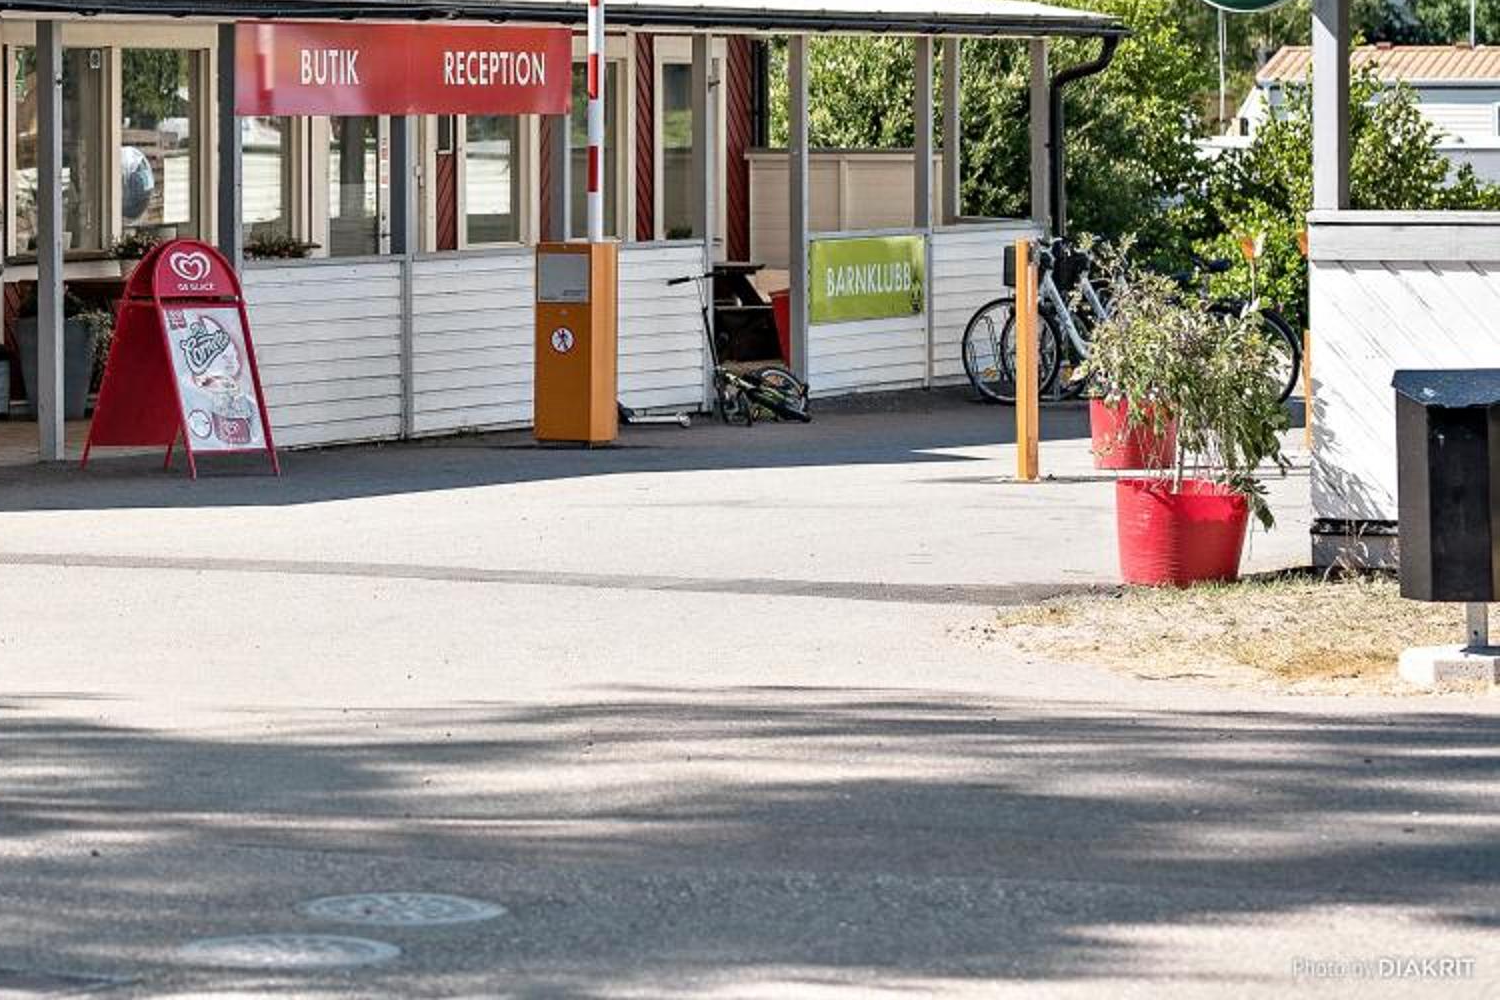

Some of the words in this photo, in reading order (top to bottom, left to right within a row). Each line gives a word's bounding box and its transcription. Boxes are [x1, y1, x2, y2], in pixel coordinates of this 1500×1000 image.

[300, 49, 359, 86] BUTIK
[443, 51, 546, 86] RECEPTION
[827, 262, 911, 297] BARNKLUBB
